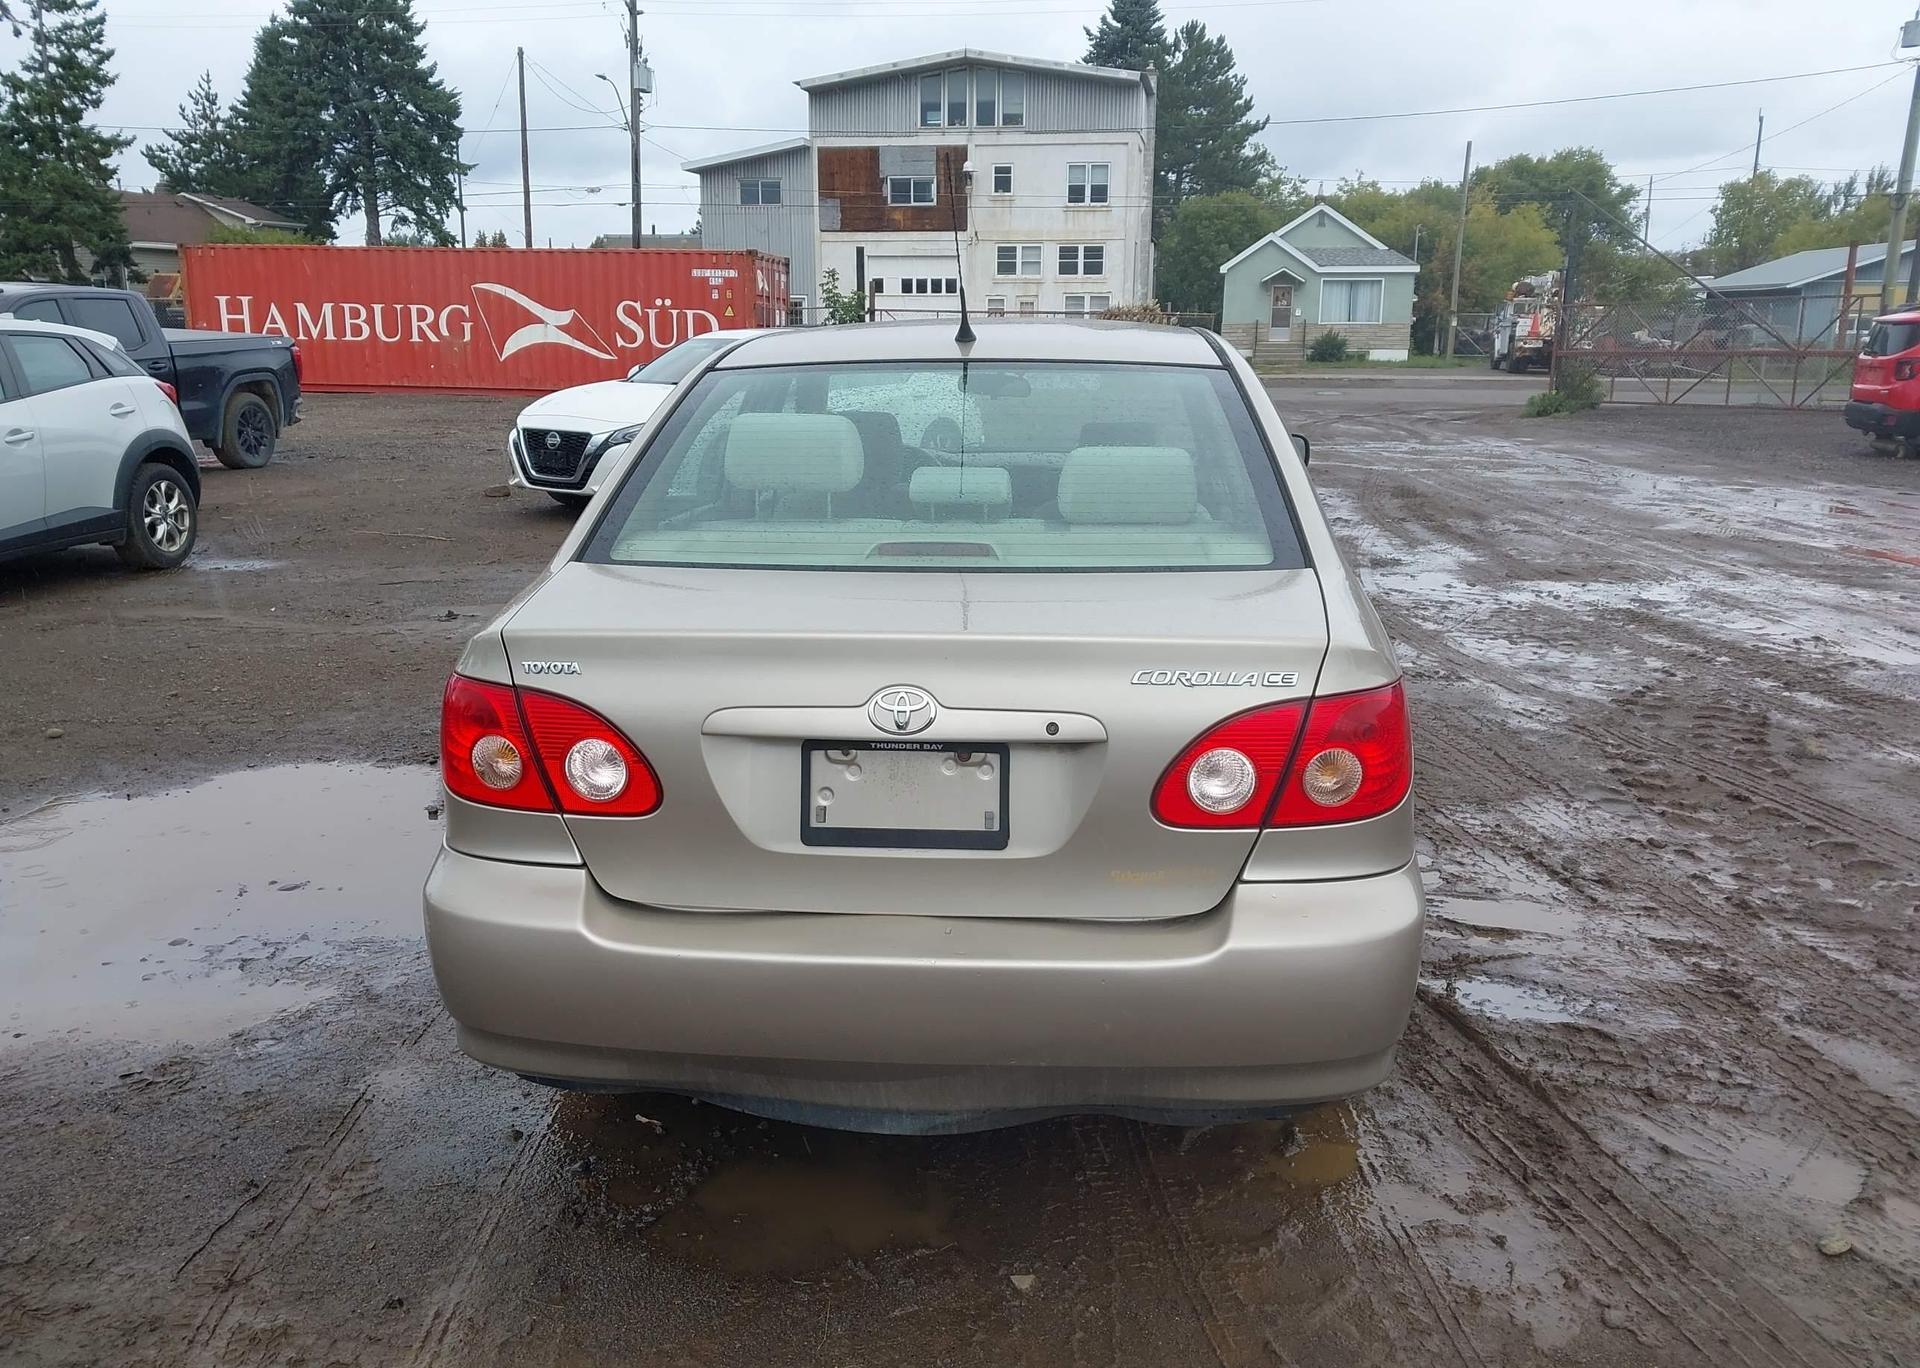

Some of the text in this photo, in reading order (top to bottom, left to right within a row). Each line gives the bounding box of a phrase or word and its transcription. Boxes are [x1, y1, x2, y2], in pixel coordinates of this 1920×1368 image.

[214, 295, 720, 349] HAMBURG SÜD
[521, 661, 582, 675] TOYOTA
[1131, 669, 1299, 688] COROLLA CE
[870, 742, 944, 751] THUNDER BAY
